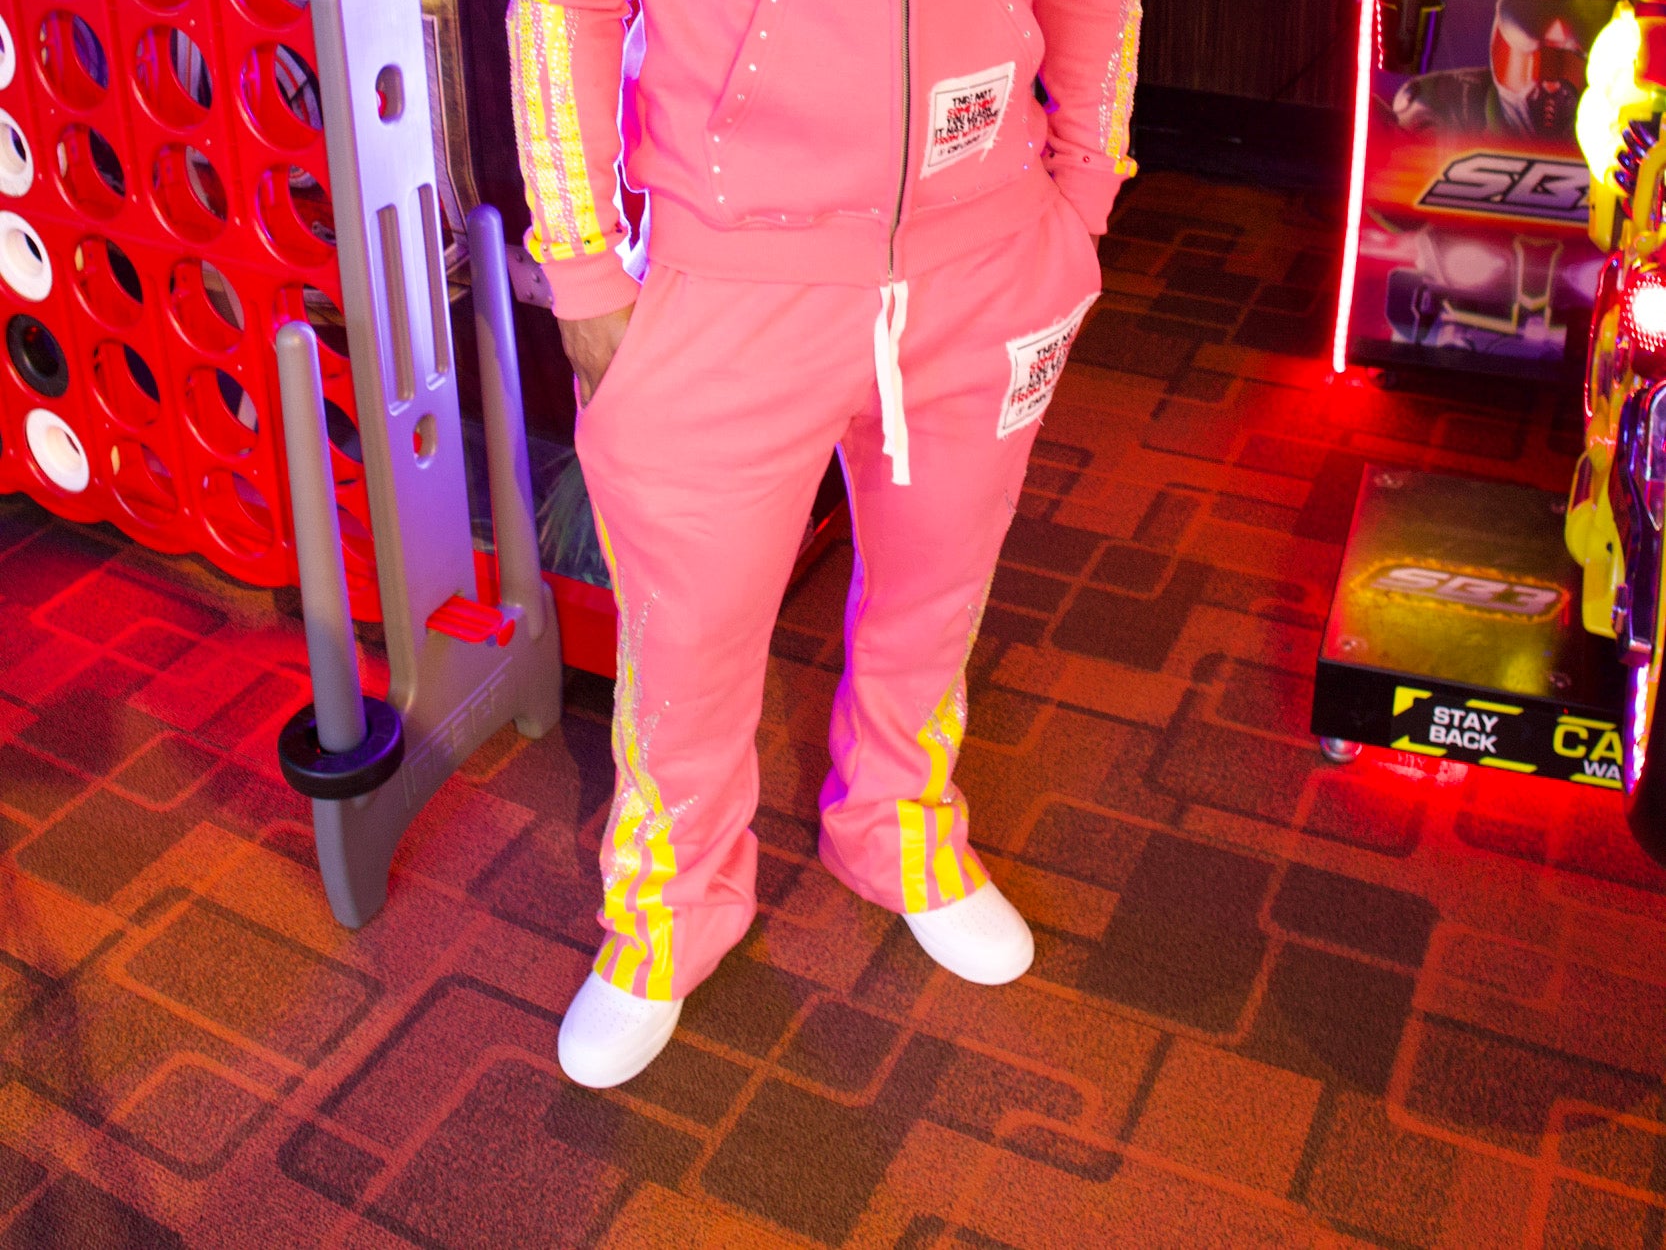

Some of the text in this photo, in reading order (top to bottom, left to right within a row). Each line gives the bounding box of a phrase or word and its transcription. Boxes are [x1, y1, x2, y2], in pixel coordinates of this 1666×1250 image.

[1370, 566, 1558, 616] SB3
[1432, 705, 1499, 734] STAY
[1429, 724, 1497, 754] BACK
[1552, 723, 1623, 767] CA
[1582, 758, 1621, 781] WA
